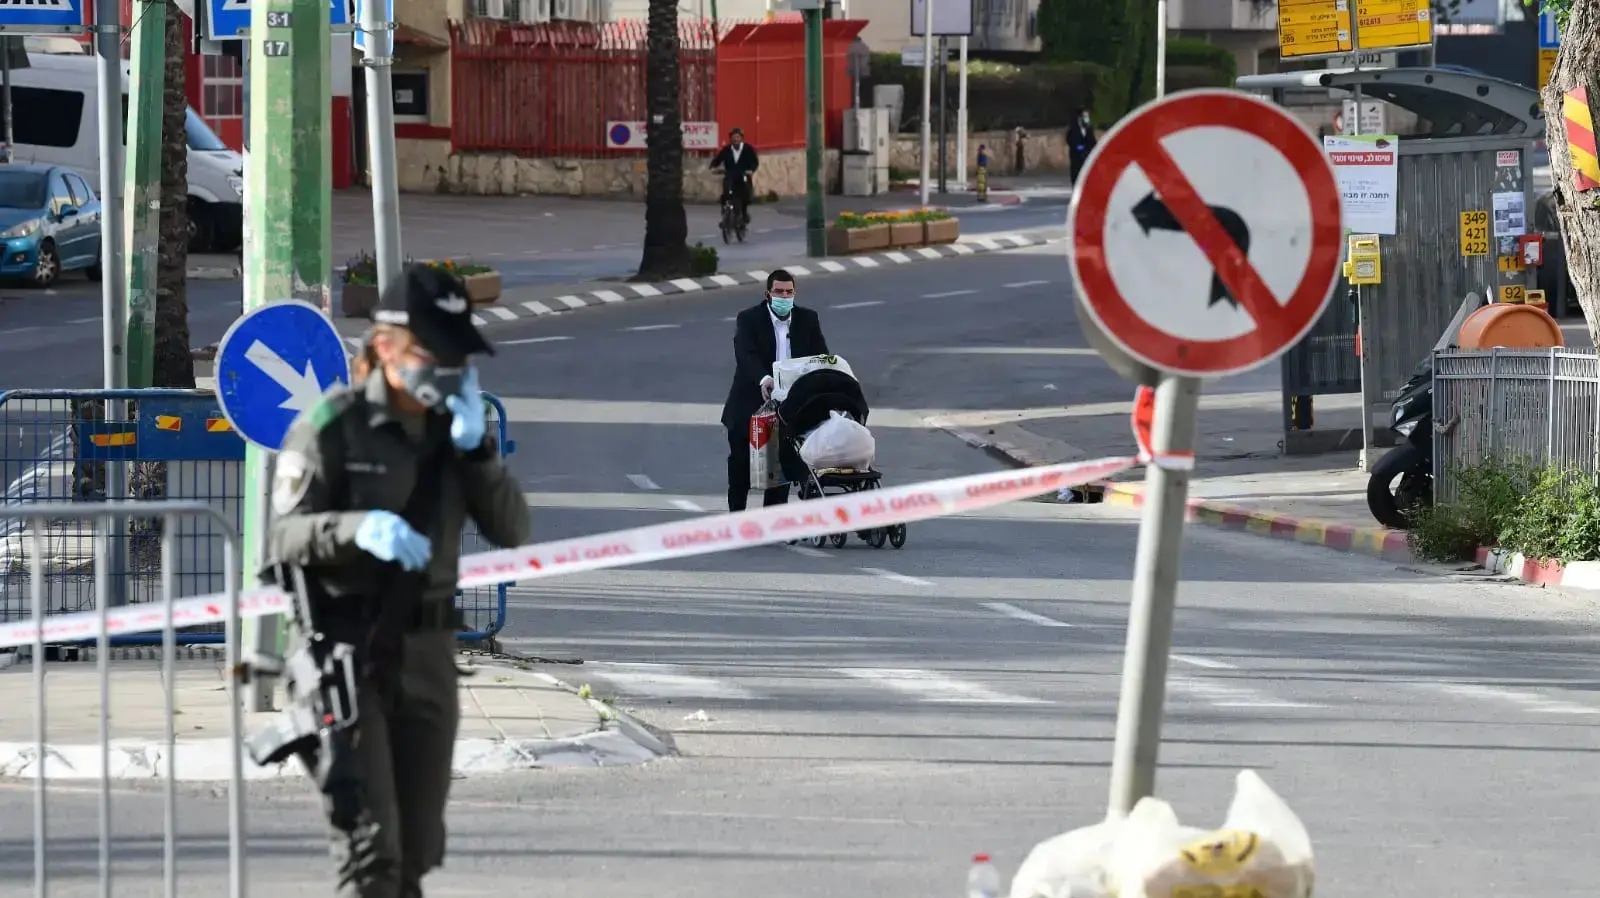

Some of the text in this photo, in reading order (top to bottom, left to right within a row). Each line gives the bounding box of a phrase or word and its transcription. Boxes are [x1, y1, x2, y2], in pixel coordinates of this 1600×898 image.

[265, 41, 285, 56] 17
[1370, 192, 1390, 200] תחנה
[1464, 212, 1487, 225] 349
[1465, 228, 1486, 239] 421
[1465, 243, 1487, 254] 422
[1505, 258, 1520, 269] 11
[1504, 287, 1521, 299] 92
